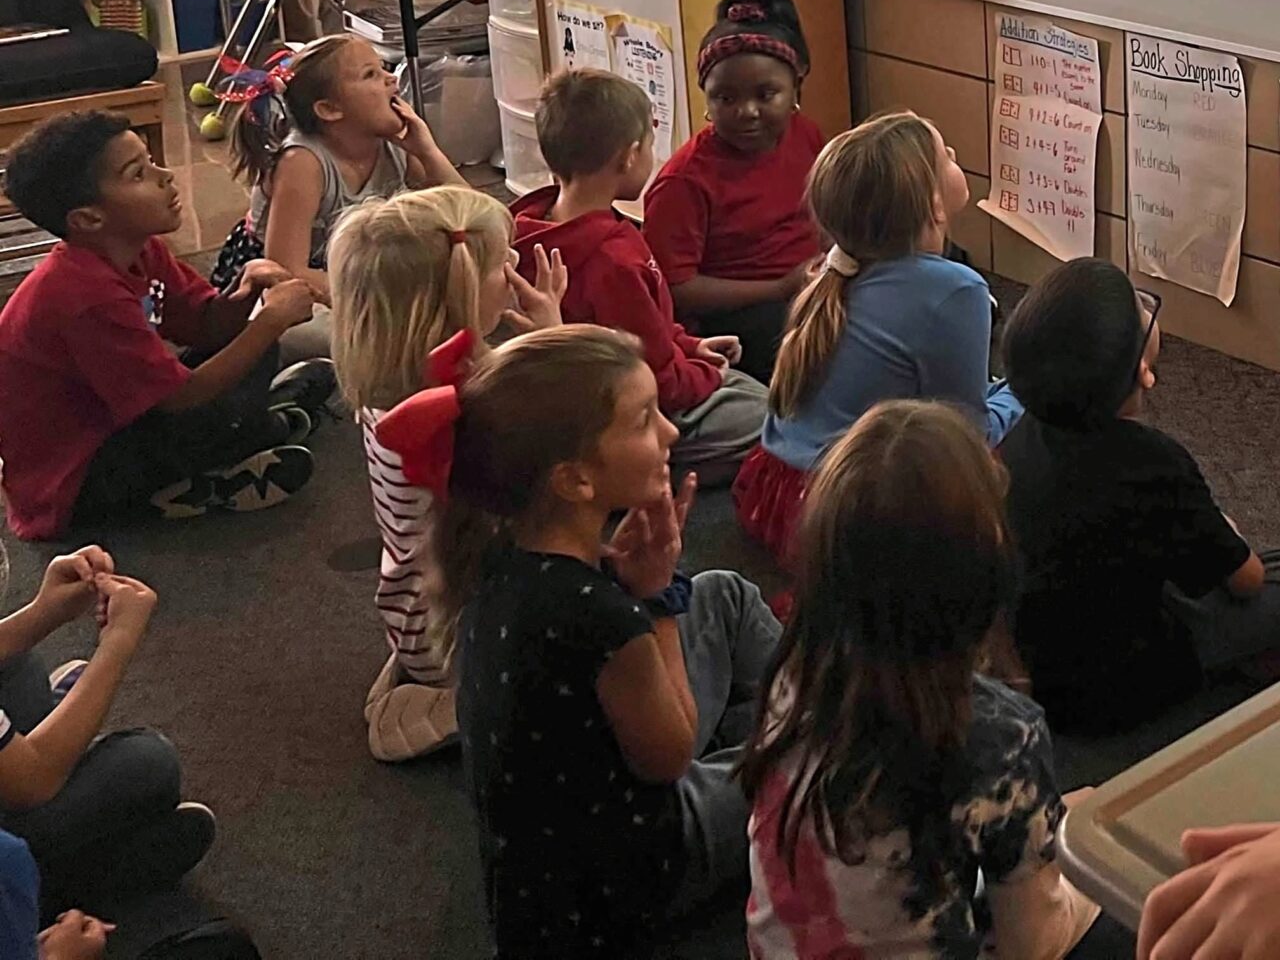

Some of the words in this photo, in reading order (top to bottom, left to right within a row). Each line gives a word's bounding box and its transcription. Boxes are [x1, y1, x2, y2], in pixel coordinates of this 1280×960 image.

[1000, 15, 1040, 42] Addition
[1043, 27, 1090, 59] Strategies
[1130, 37, 1169, 76] Book
[1174, 50, 1243, 98] Shopping
[1132, 80, 1168, 110] Monday
[1133, 112, 1171, 138] Tuesday
[1133, 147, 1181, 185] Wednesday
[1133, 193, 1175, 222] Thursday
[1136, 230, 1168, 266] Friday
